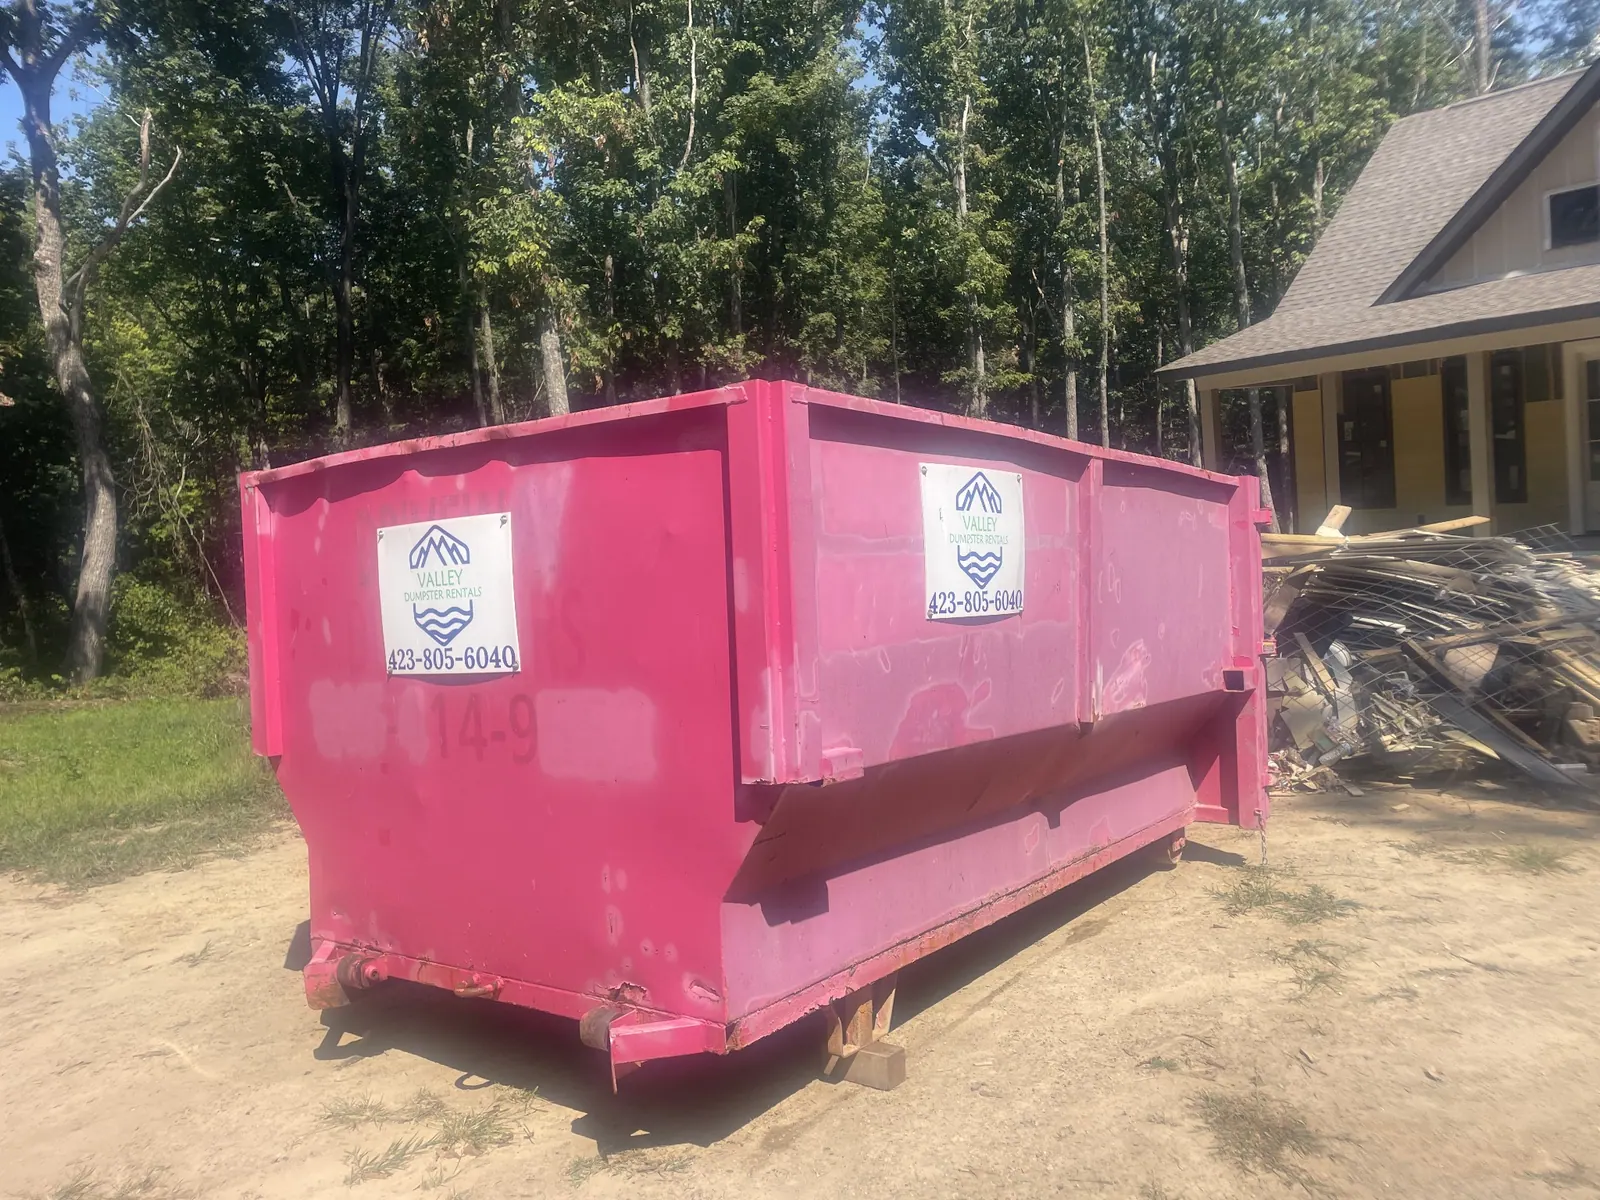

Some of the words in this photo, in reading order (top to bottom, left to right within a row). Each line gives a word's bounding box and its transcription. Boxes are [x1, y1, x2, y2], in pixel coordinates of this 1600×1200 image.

[962, 516, 998, 532] VALLEY
[949, 533, 985, 545] DUMPSTER
[985, 534, 1009, 546] RENTALS
[417, 569, 463, 588] VALLEY
[404, 589, 444, 602] DUMPSTER
[445, 587, 482, 600] RENTALS
[929, 590, 1023, 615] 423-805-6040
[388, 645, 516, 670] 423-805-6040
